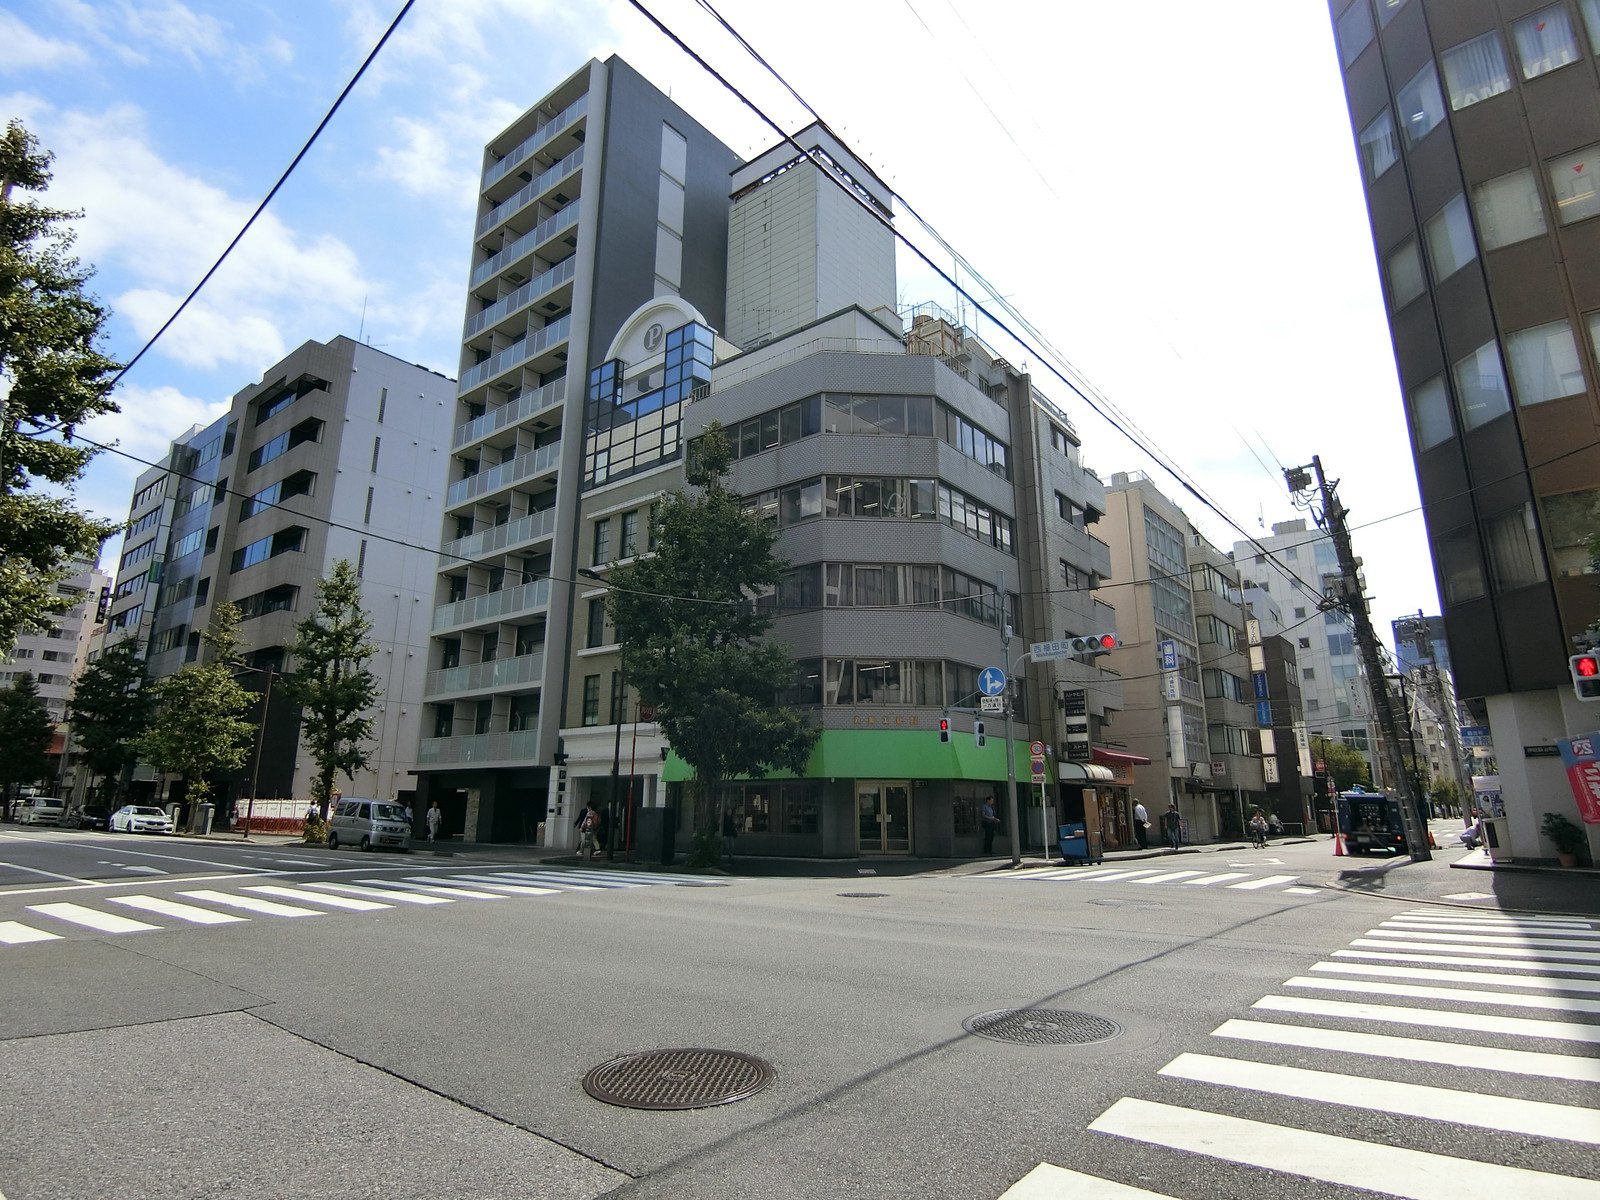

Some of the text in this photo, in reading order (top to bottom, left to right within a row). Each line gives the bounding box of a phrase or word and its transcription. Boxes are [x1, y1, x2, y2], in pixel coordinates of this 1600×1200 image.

[646, 325, 662, 349] P
[1034, 641, 1069, 653] 西福田町
[1163, 644, 1175, 666] 歯科
